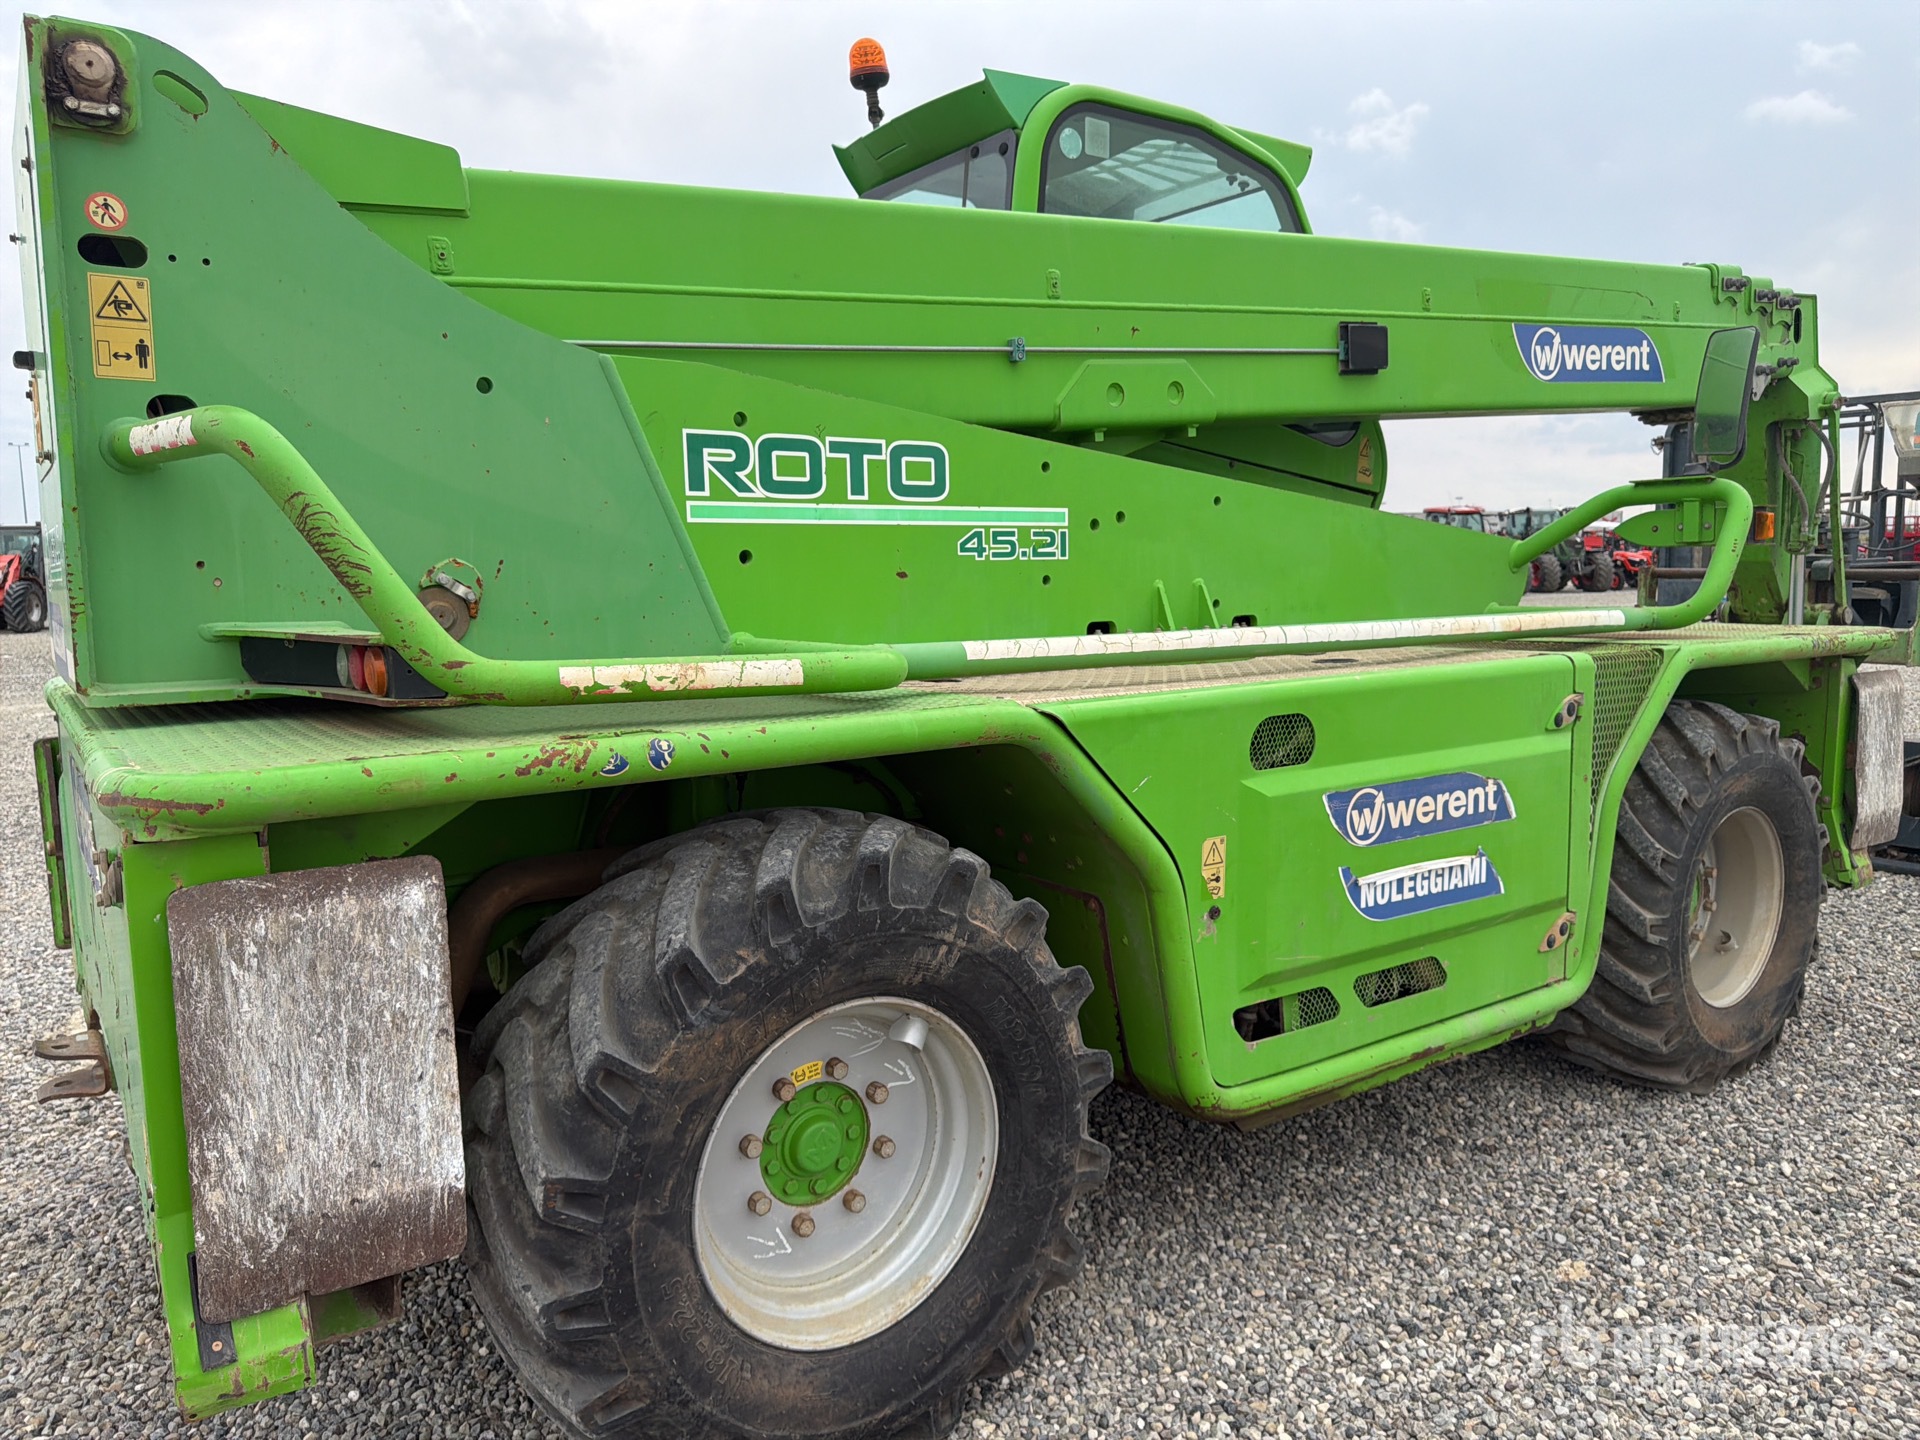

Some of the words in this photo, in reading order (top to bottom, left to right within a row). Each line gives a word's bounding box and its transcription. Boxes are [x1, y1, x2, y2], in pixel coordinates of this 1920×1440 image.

[1563, 339, 1650, 371] werent
[682, 428, 950, 502] ROTO
[957, 528, 1069, 560] 45.21
[1387, 778, 1498, 829] werent
